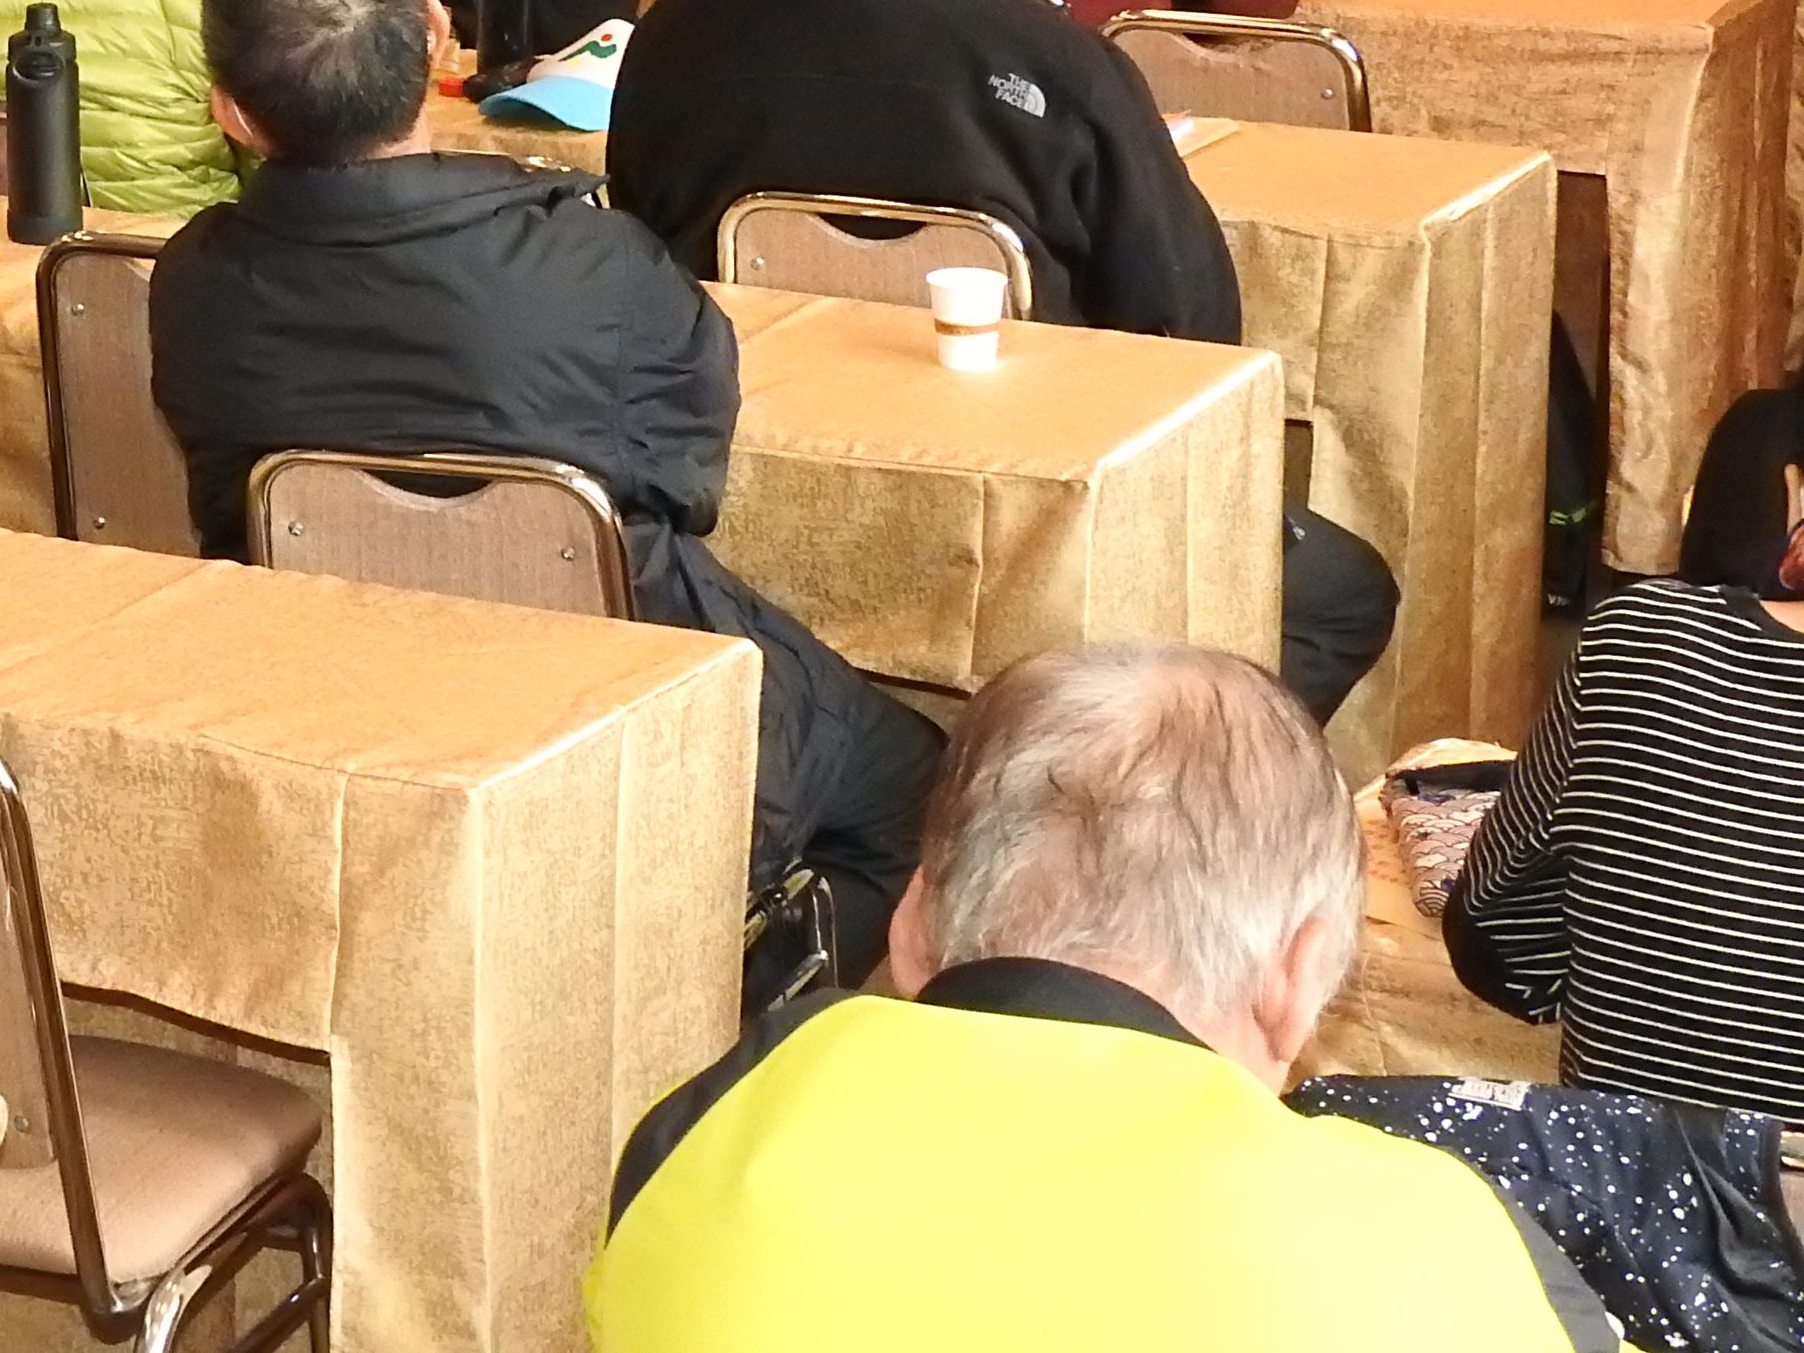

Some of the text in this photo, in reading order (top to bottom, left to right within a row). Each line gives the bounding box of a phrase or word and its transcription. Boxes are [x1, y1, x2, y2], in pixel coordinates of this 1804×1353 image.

[988, 75, 1029, 99] NORTH
[1009, 73, 1030, 87] THE
[996, 88, 1025, 109] FACE
